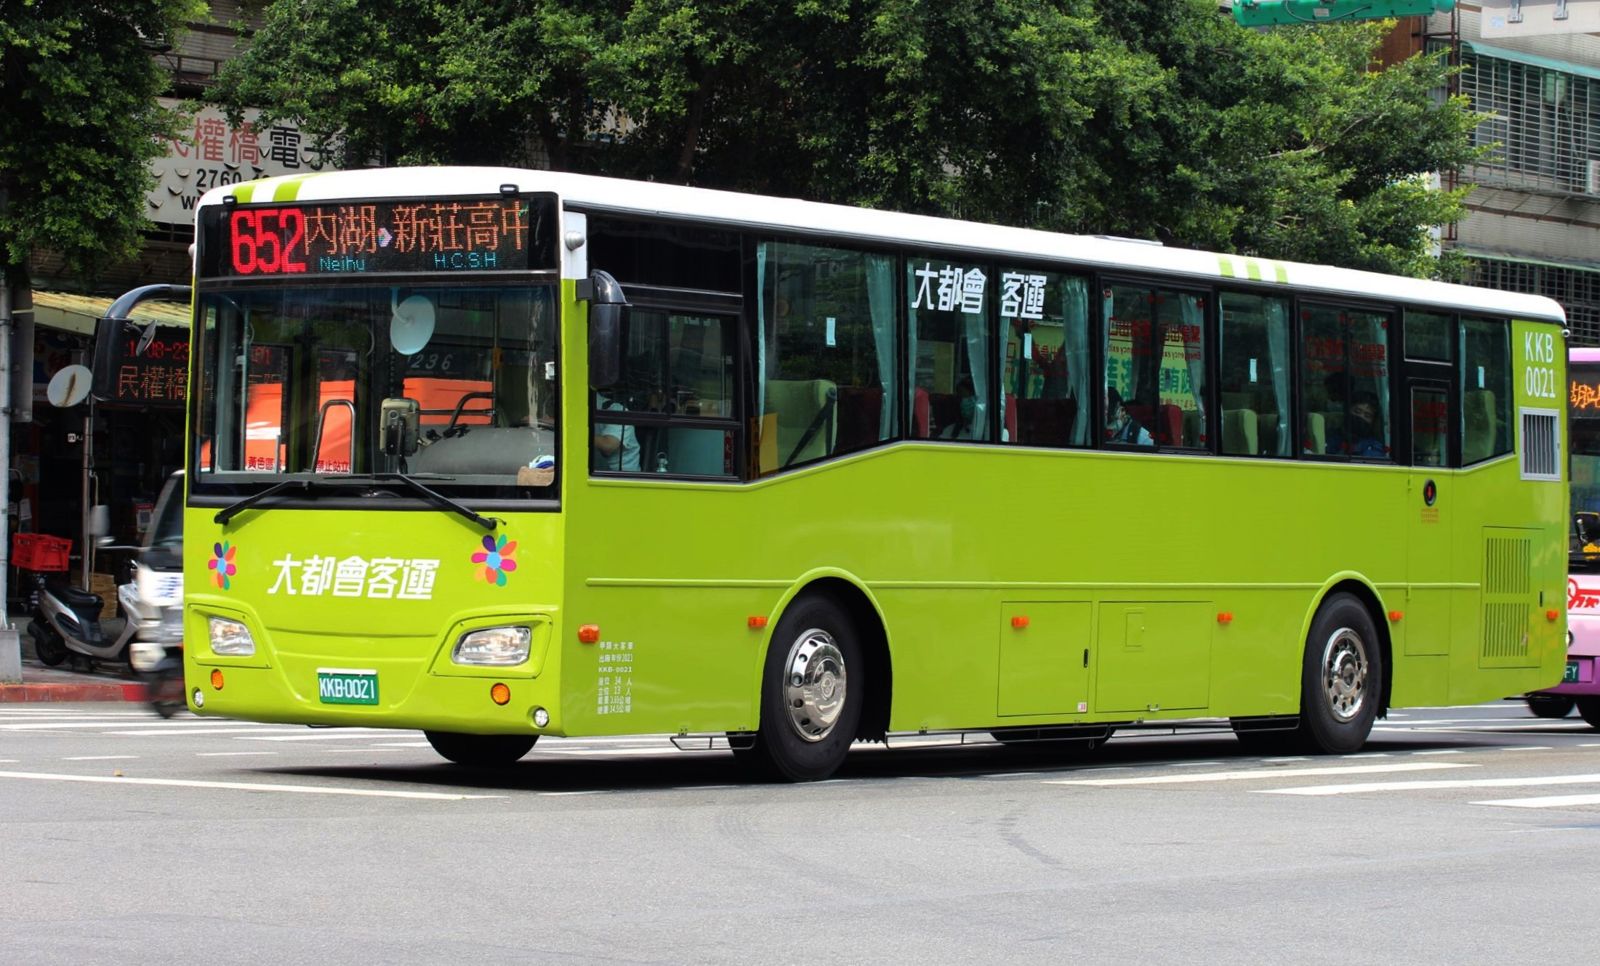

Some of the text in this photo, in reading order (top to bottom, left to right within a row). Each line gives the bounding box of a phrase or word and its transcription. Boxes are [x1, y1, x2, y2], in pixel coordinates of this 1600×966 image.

[196, 169, 270, 188] 2760-
[230, 208, 306, 274] 652
[320, 255, 365, 272] Neihu
[911, 262, 1048, 320] 大都會 客運
[1525, 332, 1554, 363] KKB
[1525, 367, 1556, 398] 0021
[267, 553, 440, 599] 大都會客運
[319, 677, 375, 699] KKB-0021
